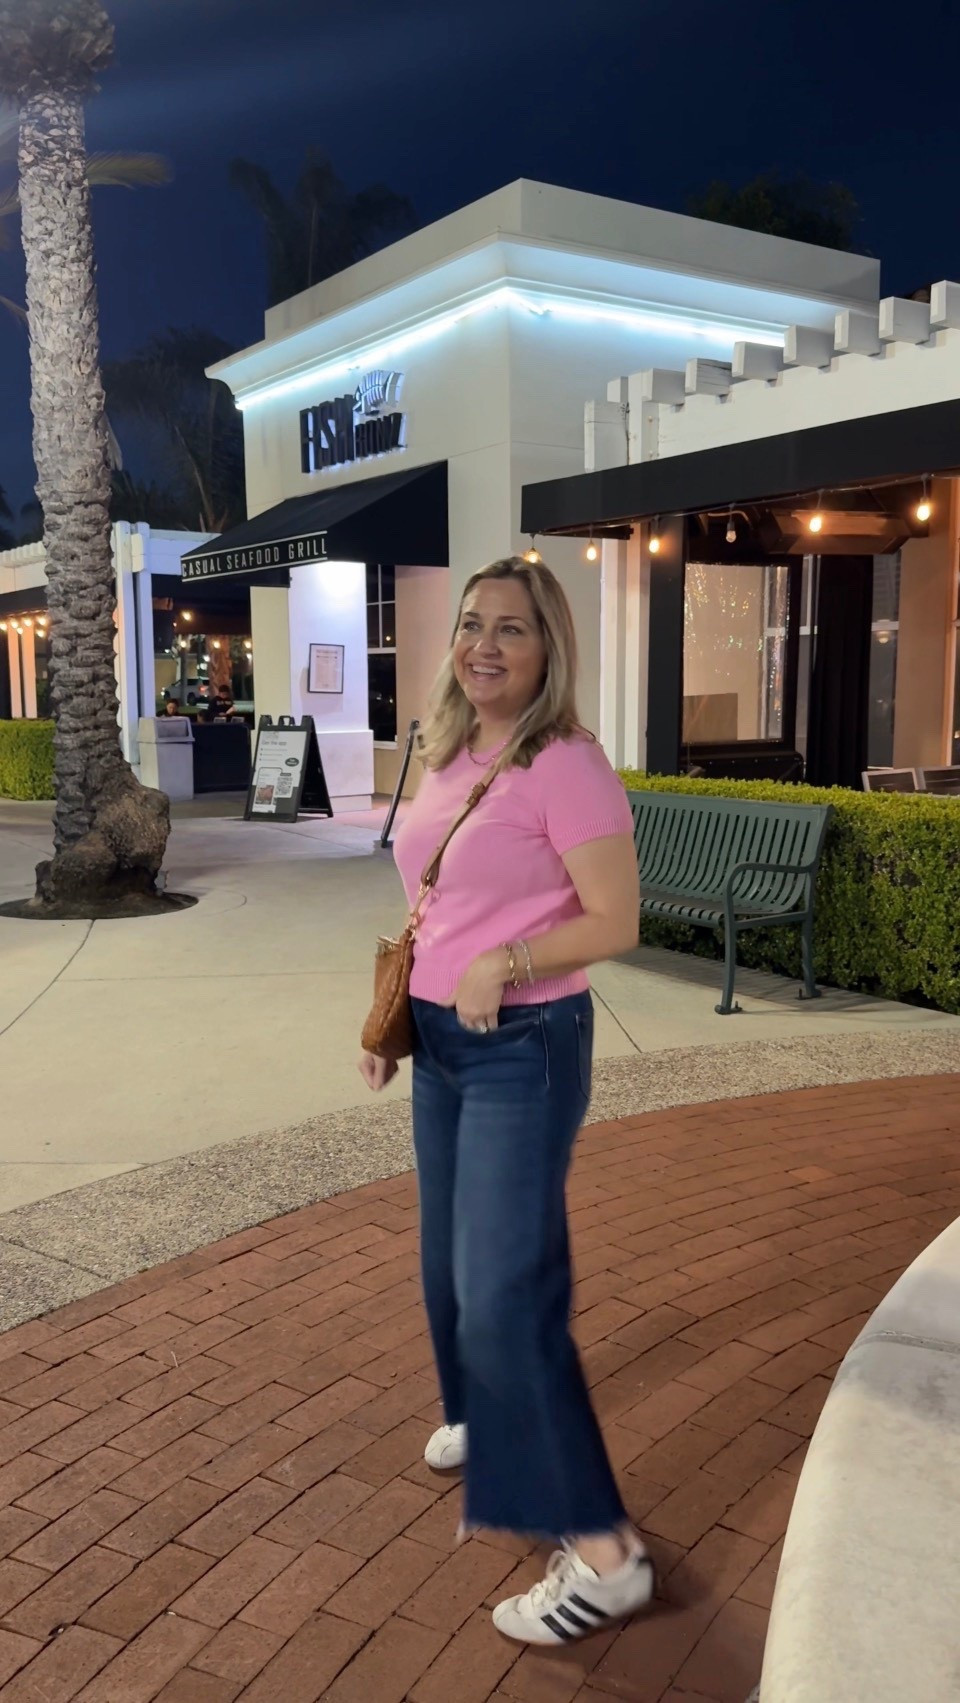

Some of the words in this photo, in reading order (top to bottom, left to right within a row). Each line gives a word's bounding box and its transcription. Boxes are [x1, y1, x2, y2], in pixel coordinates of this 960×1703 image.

[299, 393, 355, 473] FISH
[181, 556, 222, 577] CASUAL
[226, 546, 280, 570] SEAFOOD
[288, 538, 328, 560] GRILL
